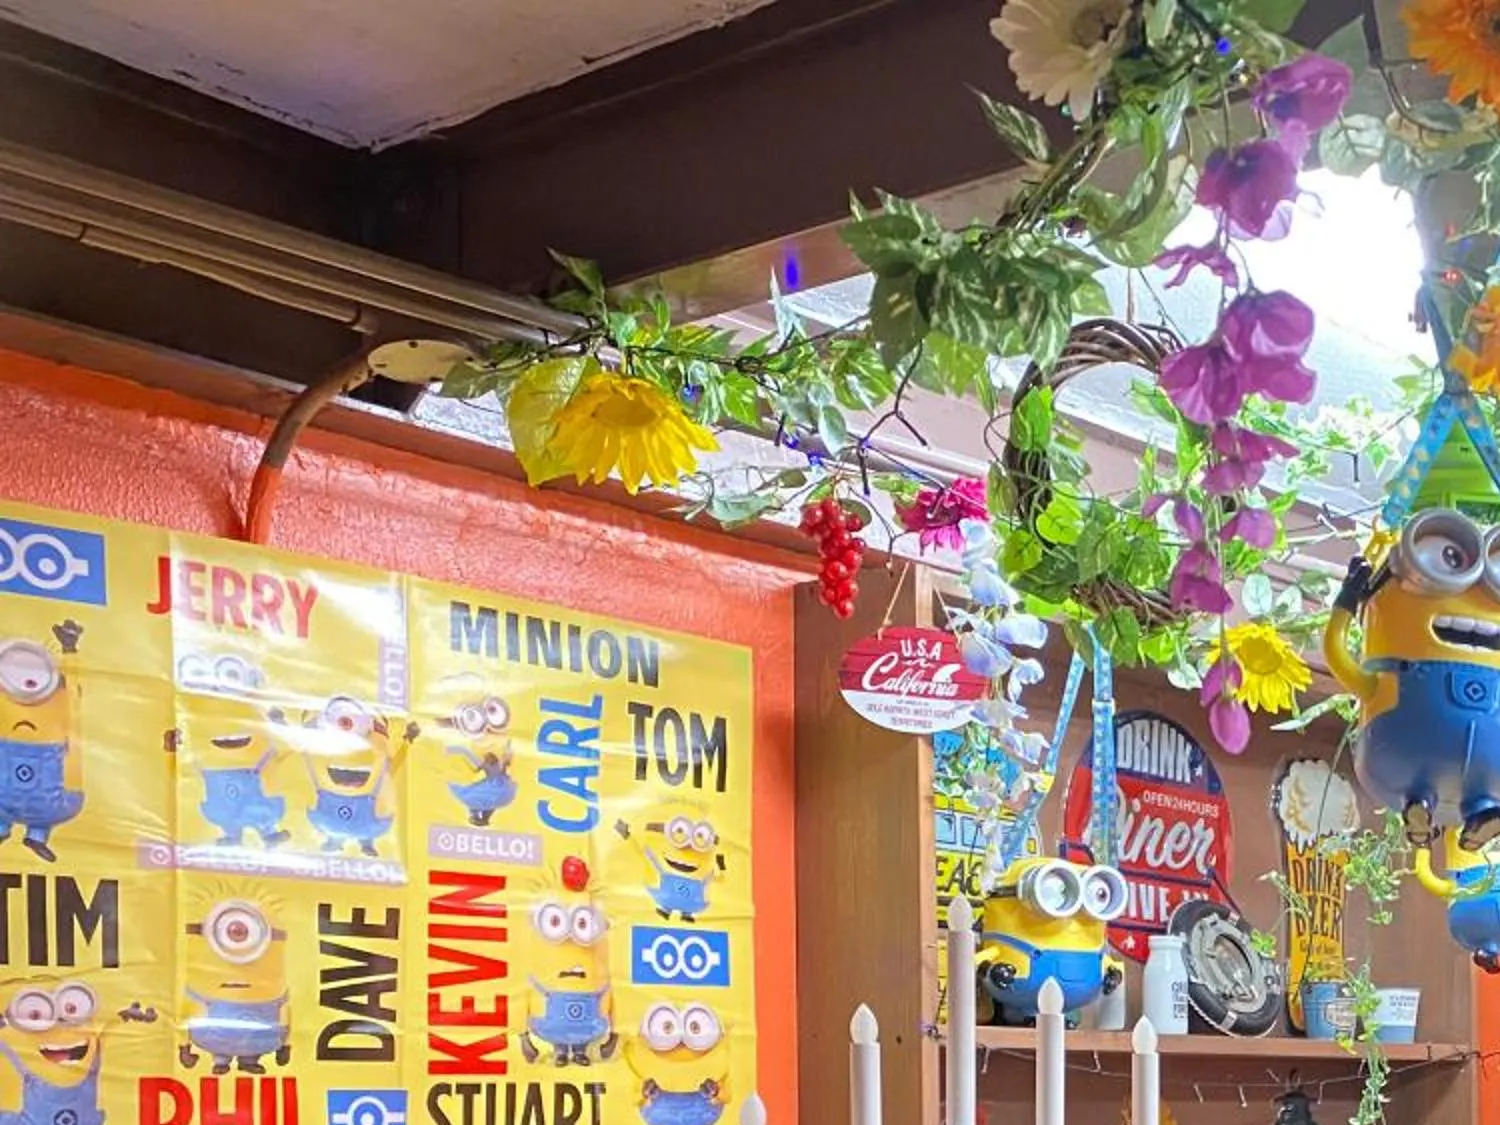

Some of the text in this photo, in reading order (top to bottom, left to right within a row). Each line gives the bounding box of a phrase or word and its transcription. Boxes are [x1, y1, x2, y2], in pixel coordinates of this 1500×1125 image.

[147, 557, 318, 639] JERRY
[450, 600, 660, 688] MINION
[537, 694, 603, 833] CARL
[628, 701, 727, 792] TOM
[1117, 719, 1192, 783] DRINK
[457, 834, 534, 858] BELLO!
[0, 873, 119, 968] TIM
[316, 902, 401, 1061] DAVE
[428, 870, 508, 1075] KEVIN
